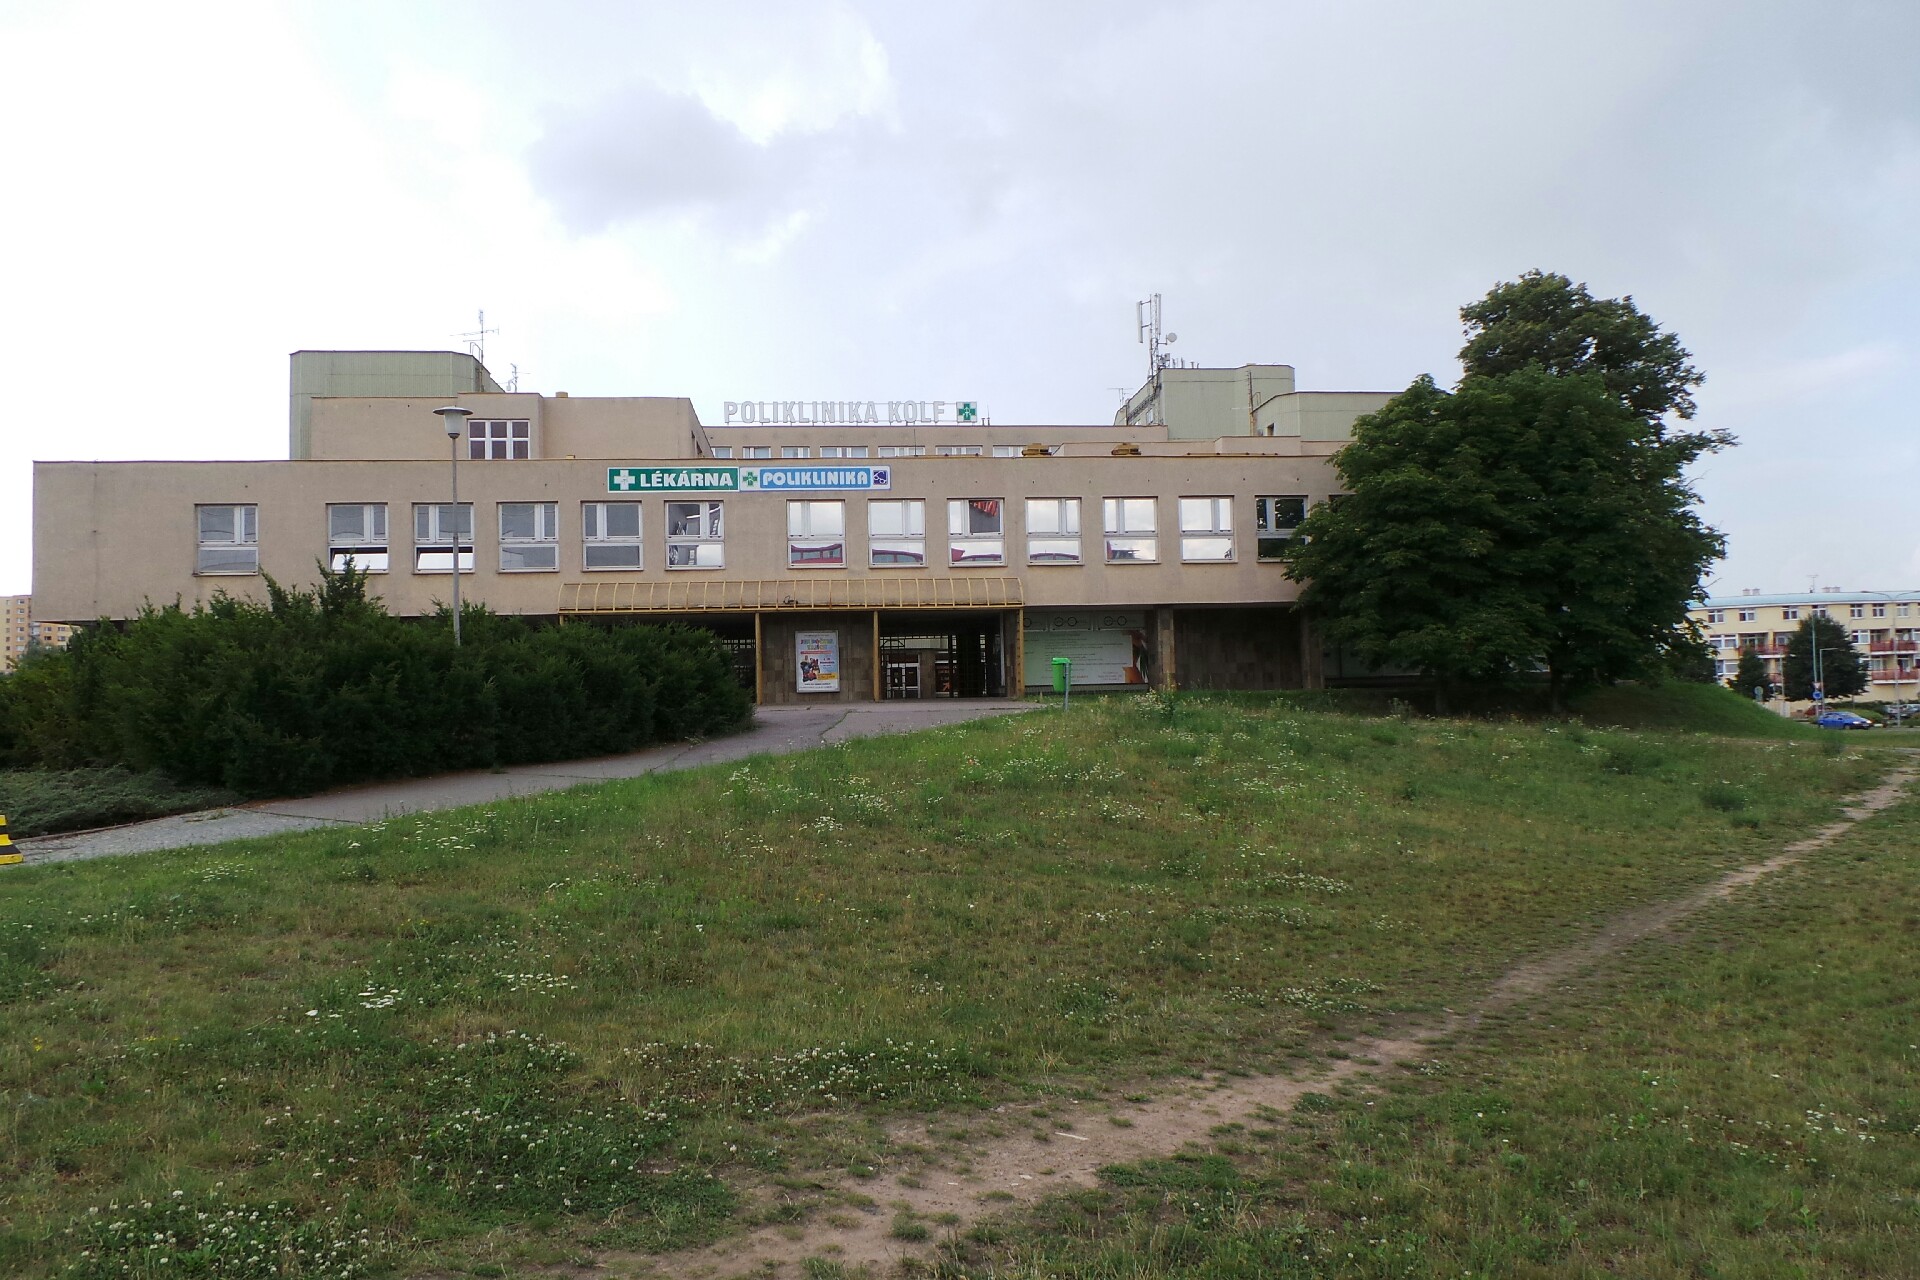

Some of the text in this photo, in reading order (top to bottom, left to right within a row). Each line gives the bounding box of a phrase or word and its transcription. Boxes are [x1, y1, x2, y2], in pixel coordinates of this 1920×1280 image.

[724, 400, 945, 424] POLIKLINIKA KOLF
[640, 470, 734, 487] LÉKÁRNA
[762, 470, 868, 486] POLIKLINIKA
